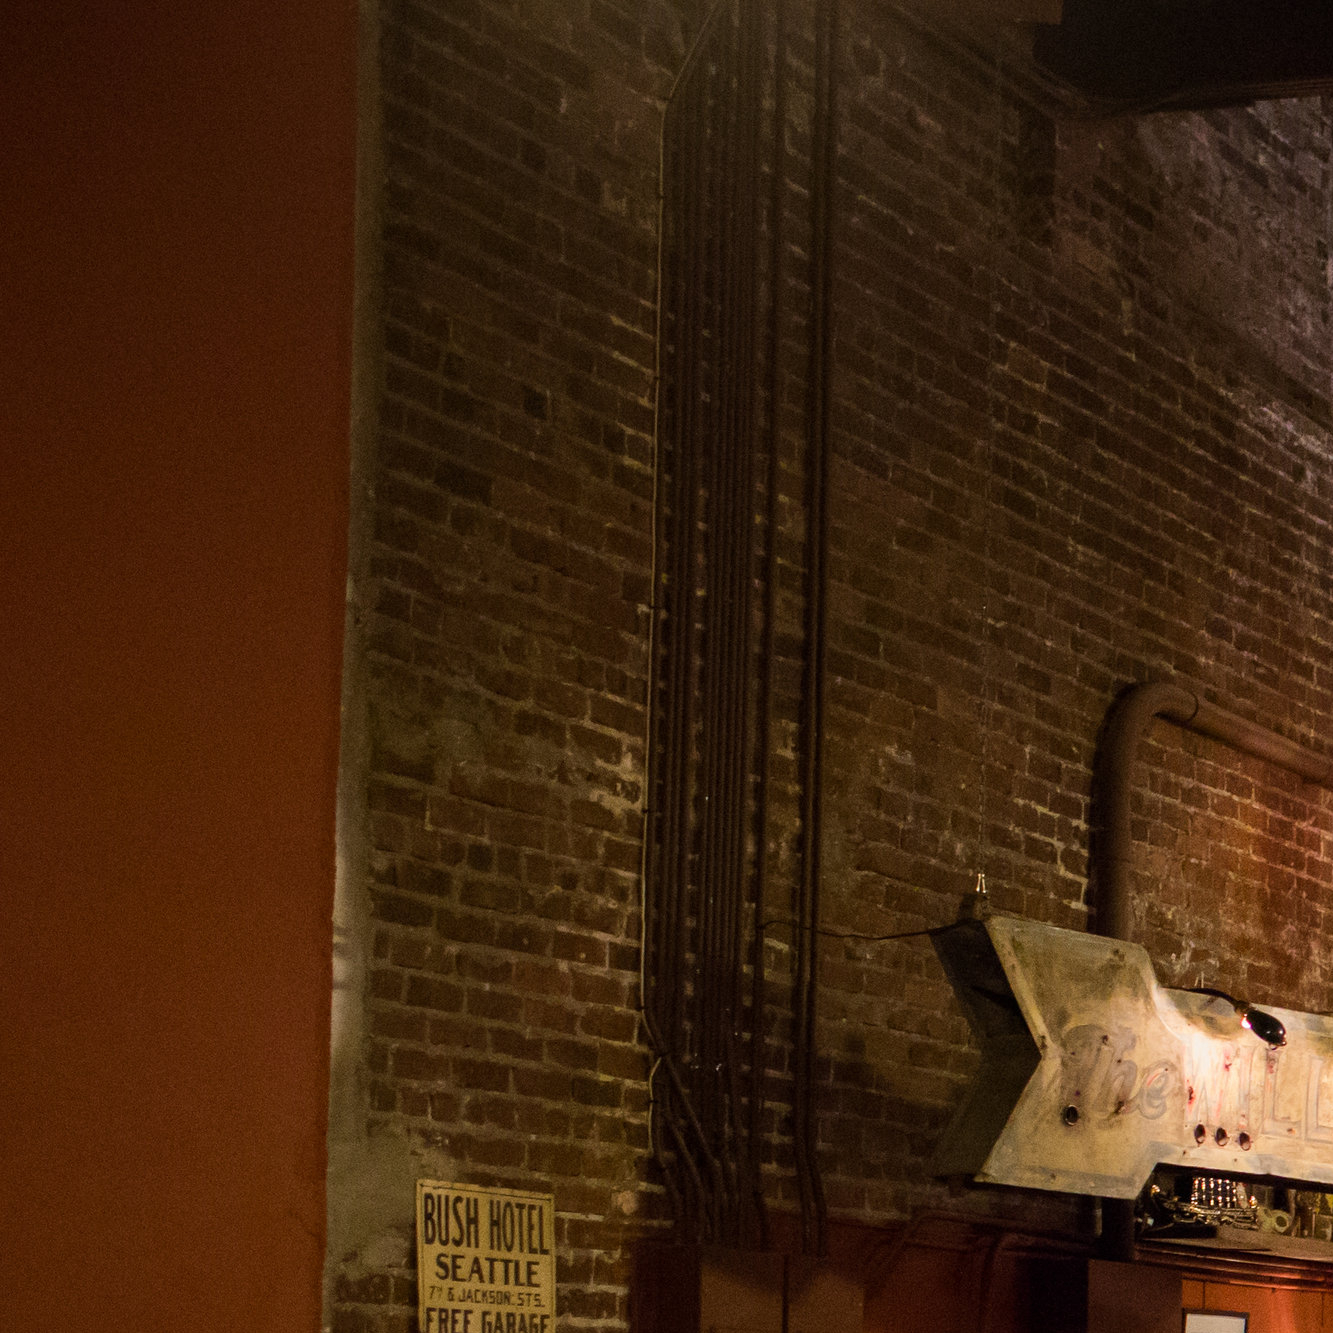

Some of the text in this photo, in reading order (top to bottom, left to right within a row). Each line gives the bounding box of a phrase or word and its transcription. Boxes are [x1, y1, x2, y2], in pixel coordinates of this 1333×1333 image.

[424, 1192, 550, 1256] BUSH HOTEL
[435, 1253, 541, 1288] SEATTLE
